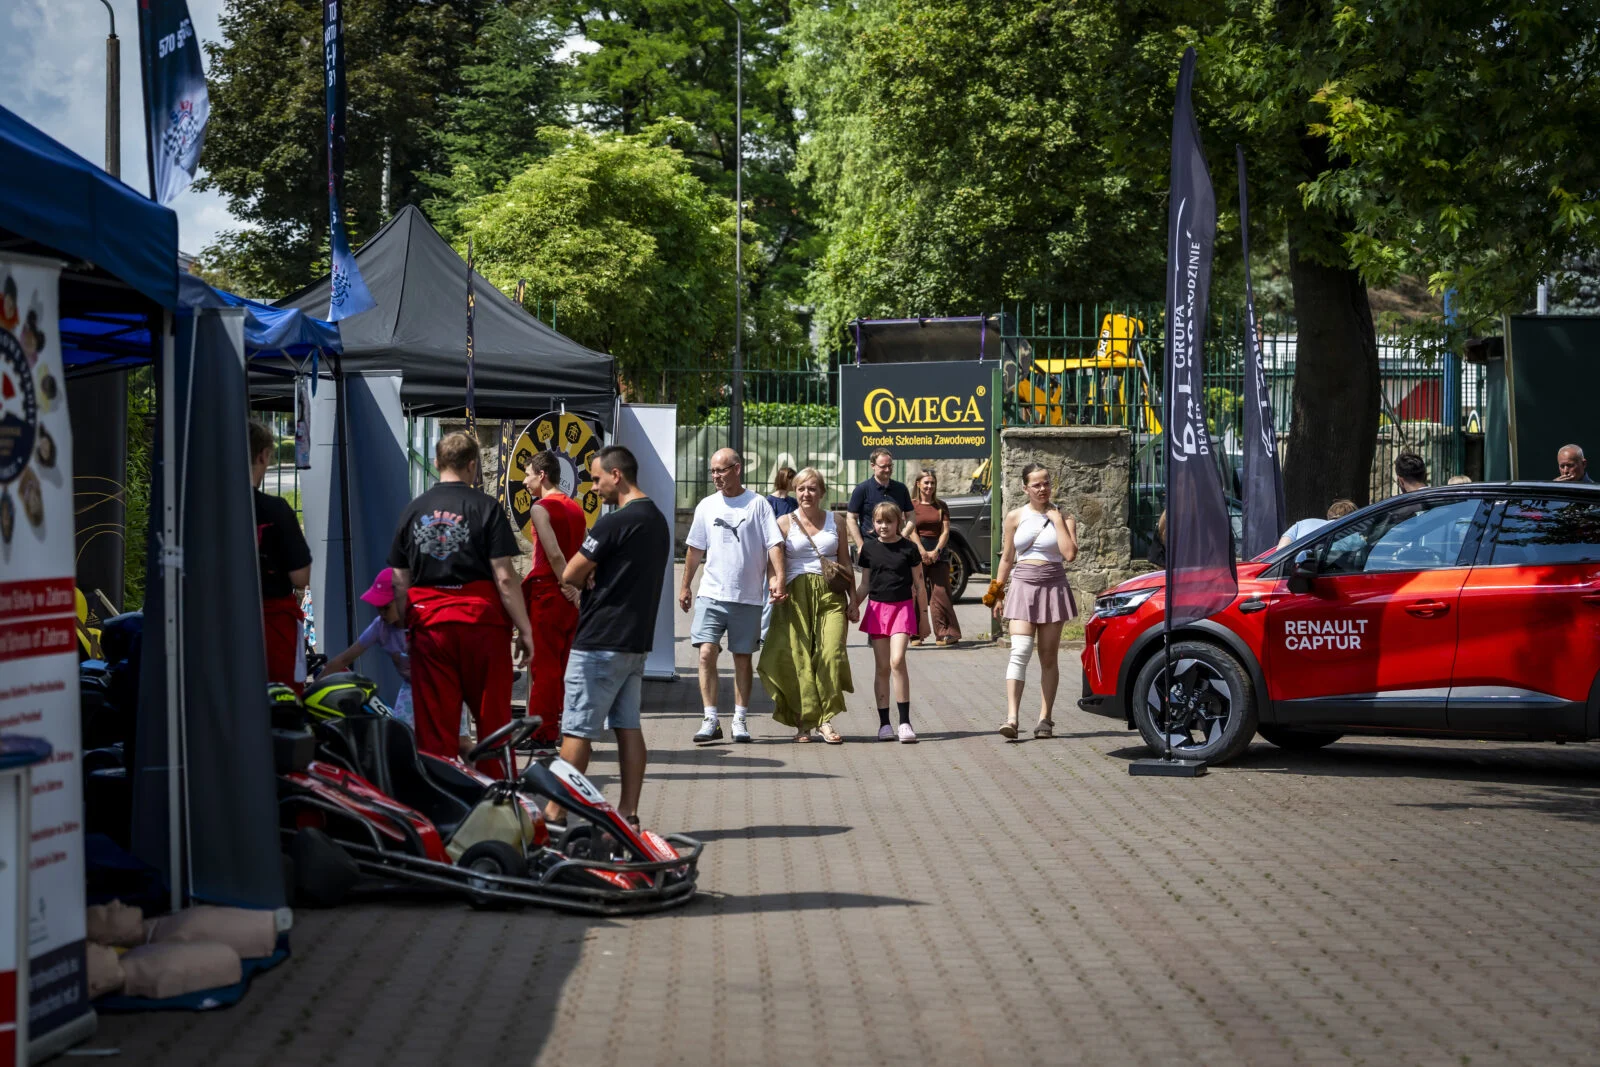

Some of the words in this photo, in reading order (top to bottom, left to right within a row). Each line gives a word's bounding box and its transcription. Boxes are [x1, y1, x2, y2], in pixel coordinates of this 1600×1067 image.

[1174, 304, 1185, 369] GRUPA
[862, 434, 894, 446] Ośrodek
[895, 435, 933, 446] Szkolenia
[934, 434, 986, 447] Zawodowego
[1284, 619, 1369, 634] RENAULT
[1285, 635, 1362, 650] CAPTUR
